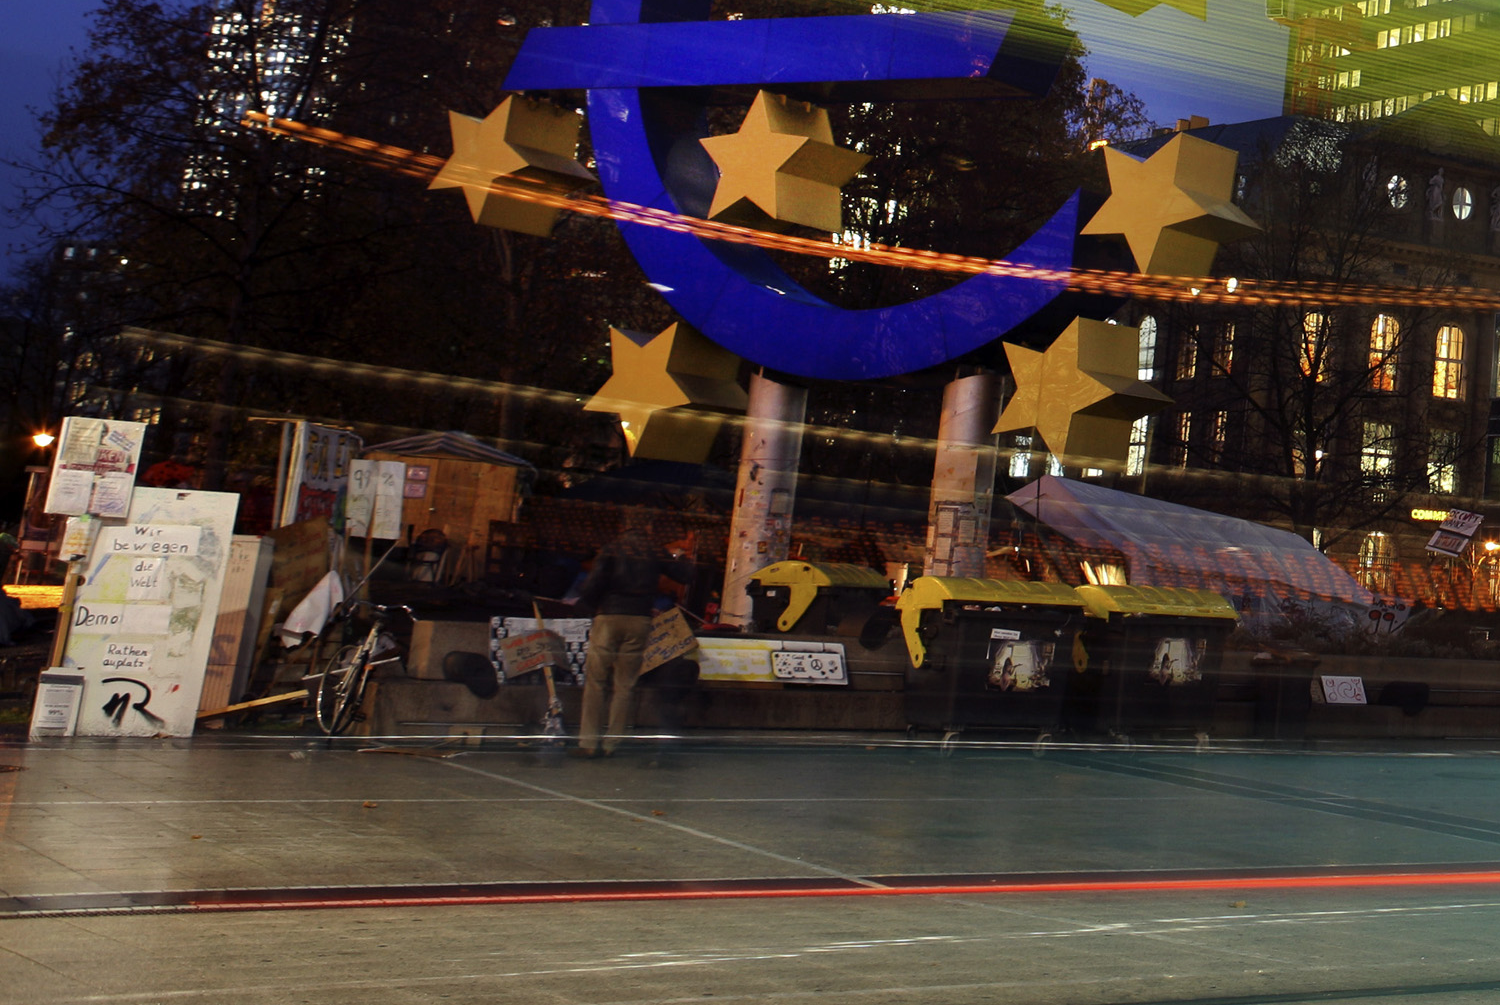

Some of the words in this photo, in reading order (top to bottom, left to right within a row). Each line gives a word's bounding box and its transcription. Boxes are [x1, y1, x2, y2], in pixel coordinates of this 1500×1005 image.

[1411, 508, 1451, 521] COMME
[134, 526, 164, 536] Wir
[113, 539, 189, 553] bewegen
[134, 561, 154, 572] die
[75, 606, 119, 626] Demo
